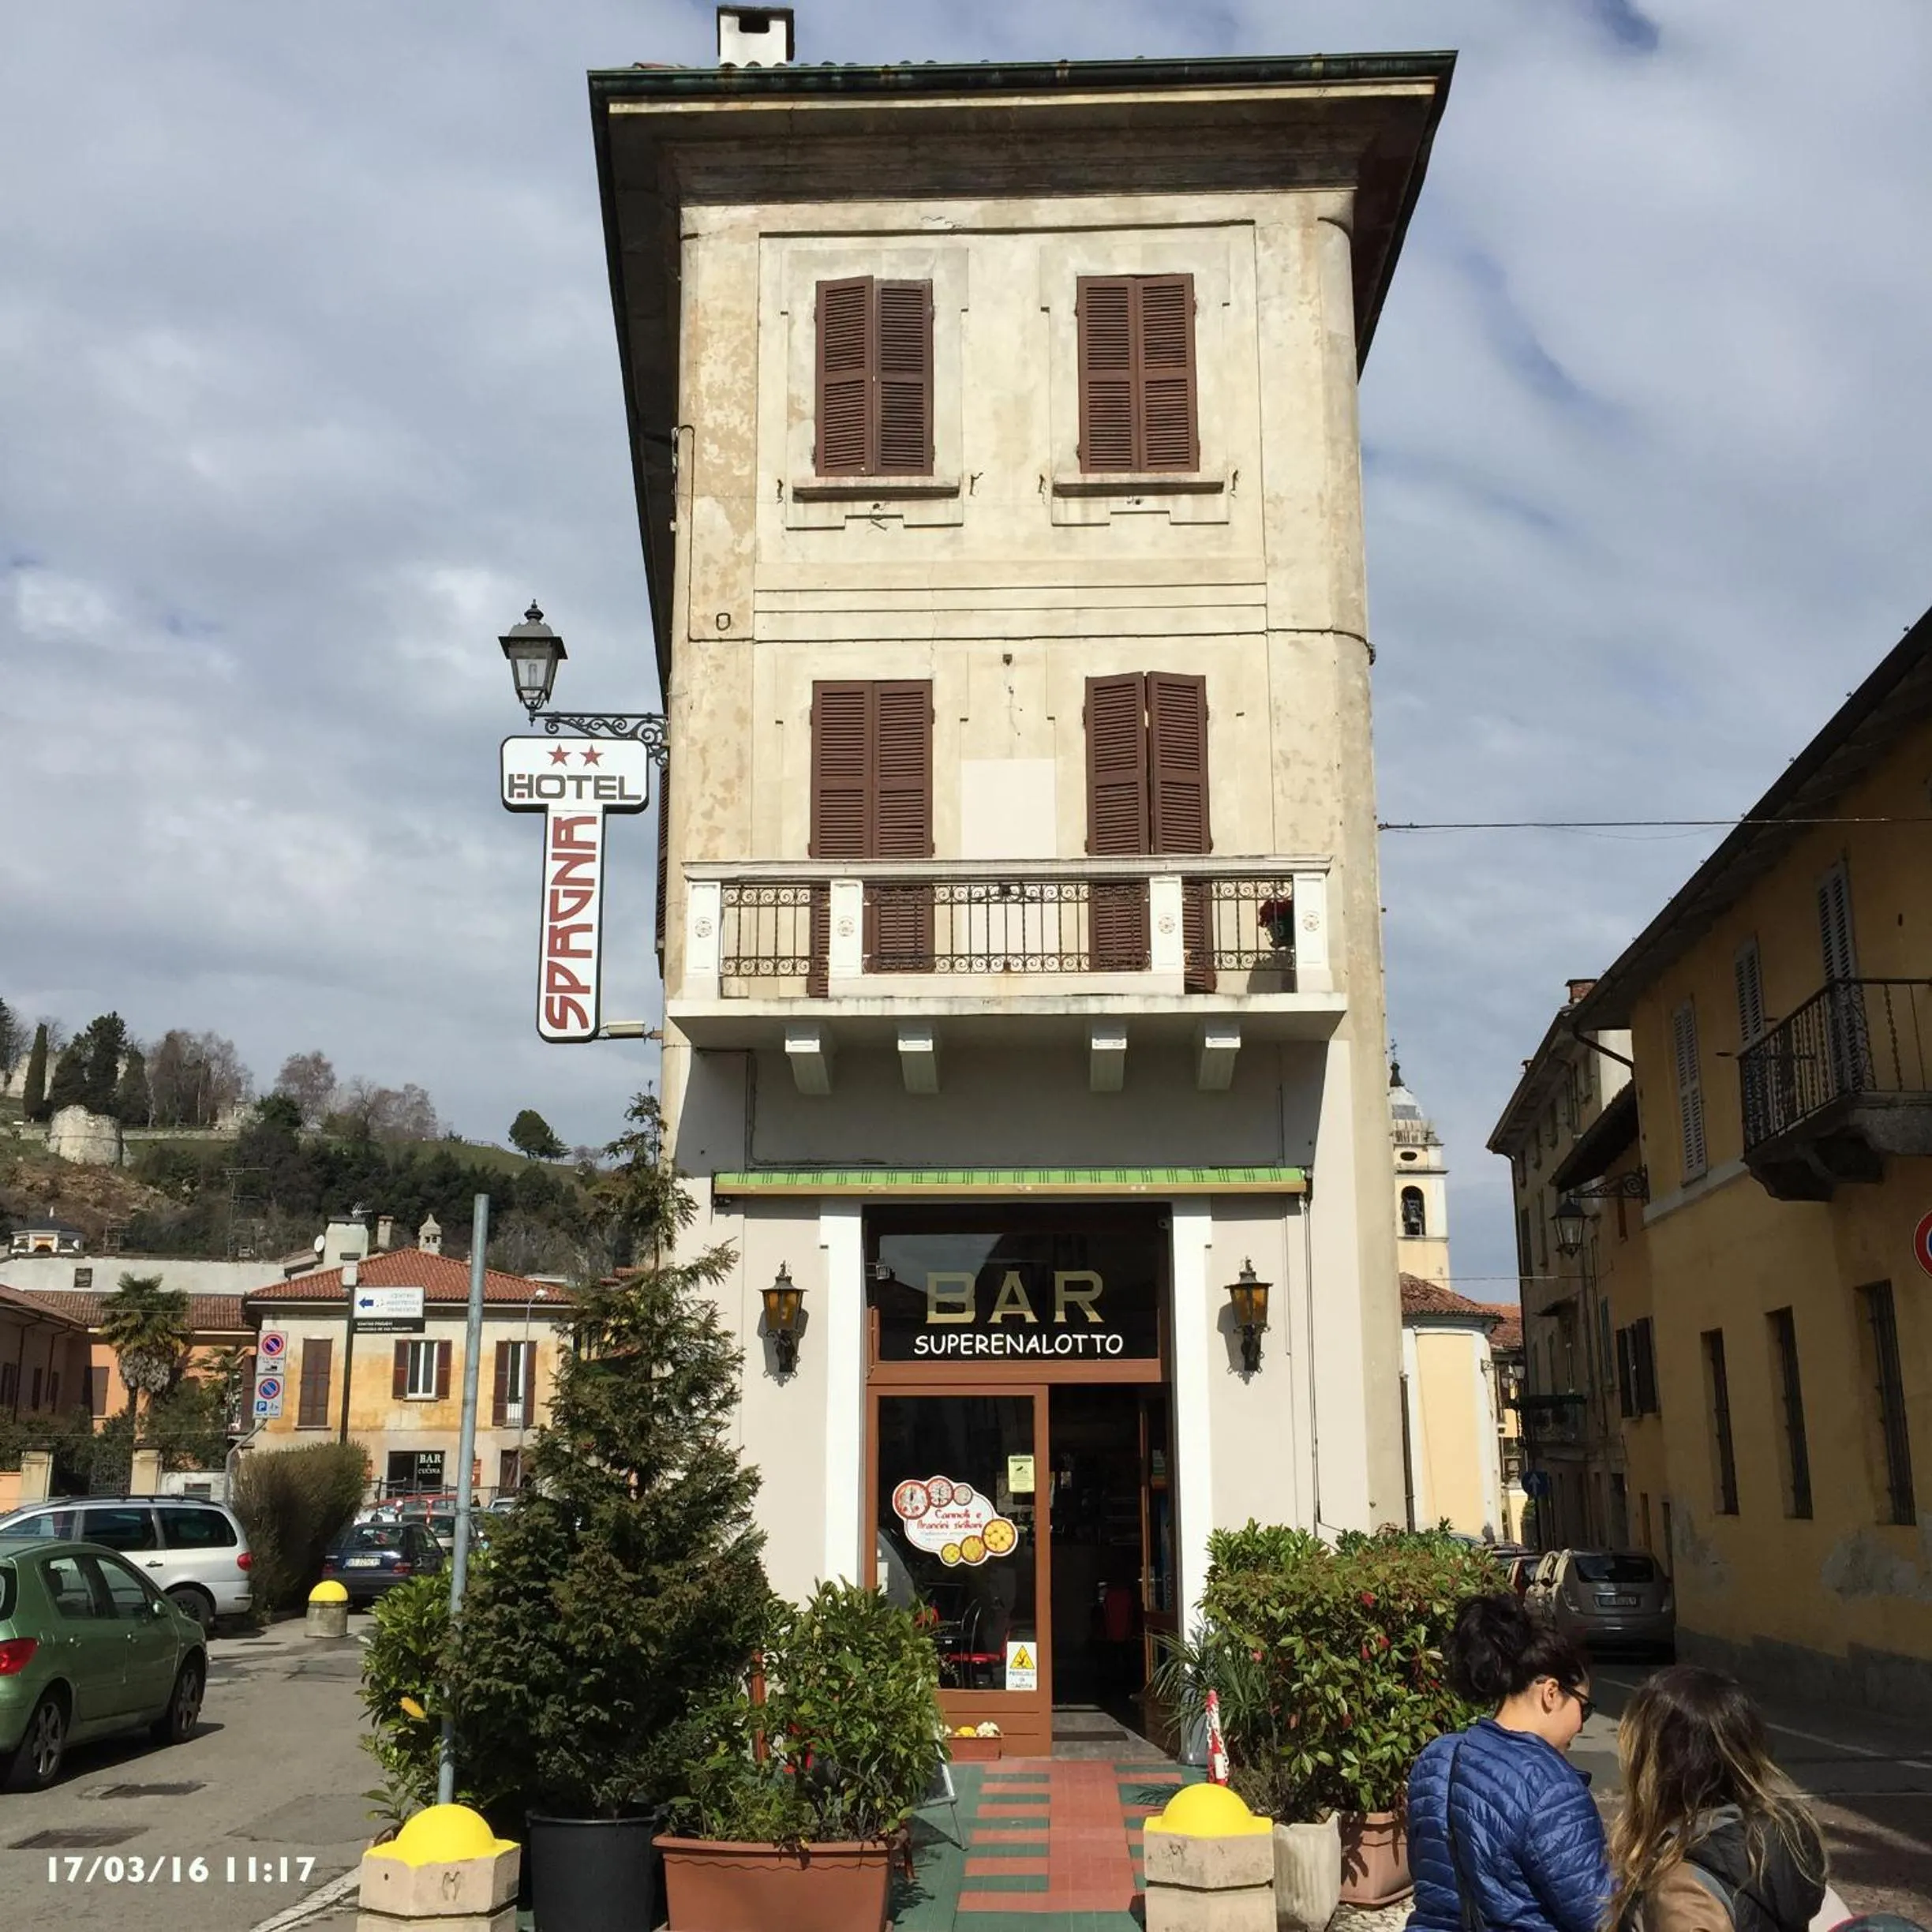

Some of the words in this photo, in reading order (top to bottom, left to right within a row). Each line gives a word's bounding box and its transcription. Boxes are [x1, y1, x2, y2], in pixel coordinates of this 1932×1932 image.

[508, 773, 642, 800] HOTEL
[545, 815, 597, 1030] SPAGNA
[926, 1271, 1105, 1324] BAR
[914, 1334, 1124, 1355] SUPERENALOTTO
[419, 1454, 441, 1464] BAR
